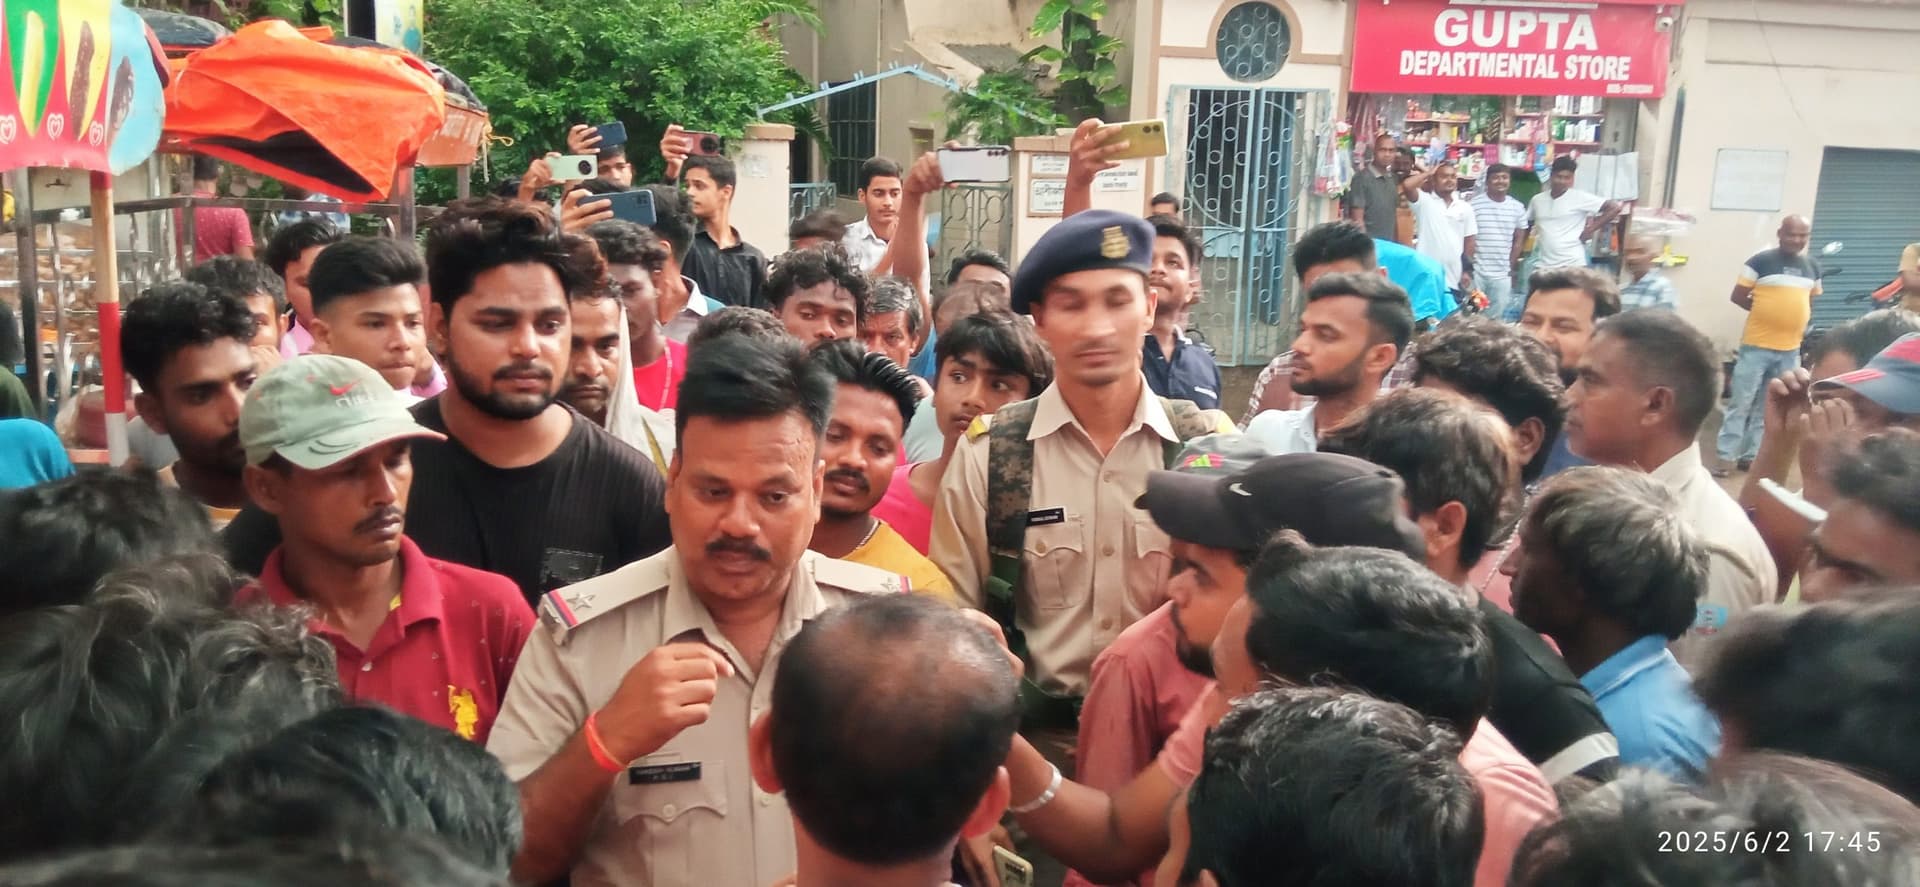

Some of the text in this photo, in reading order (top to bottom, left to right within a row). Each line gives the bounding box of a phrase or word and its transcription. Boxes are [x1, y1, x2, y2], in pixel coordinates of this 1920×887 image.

[1434, 9, 1598, 50] GUPTA
[1400, 50, 1631, 80] DEPARTMENTAL STORE
